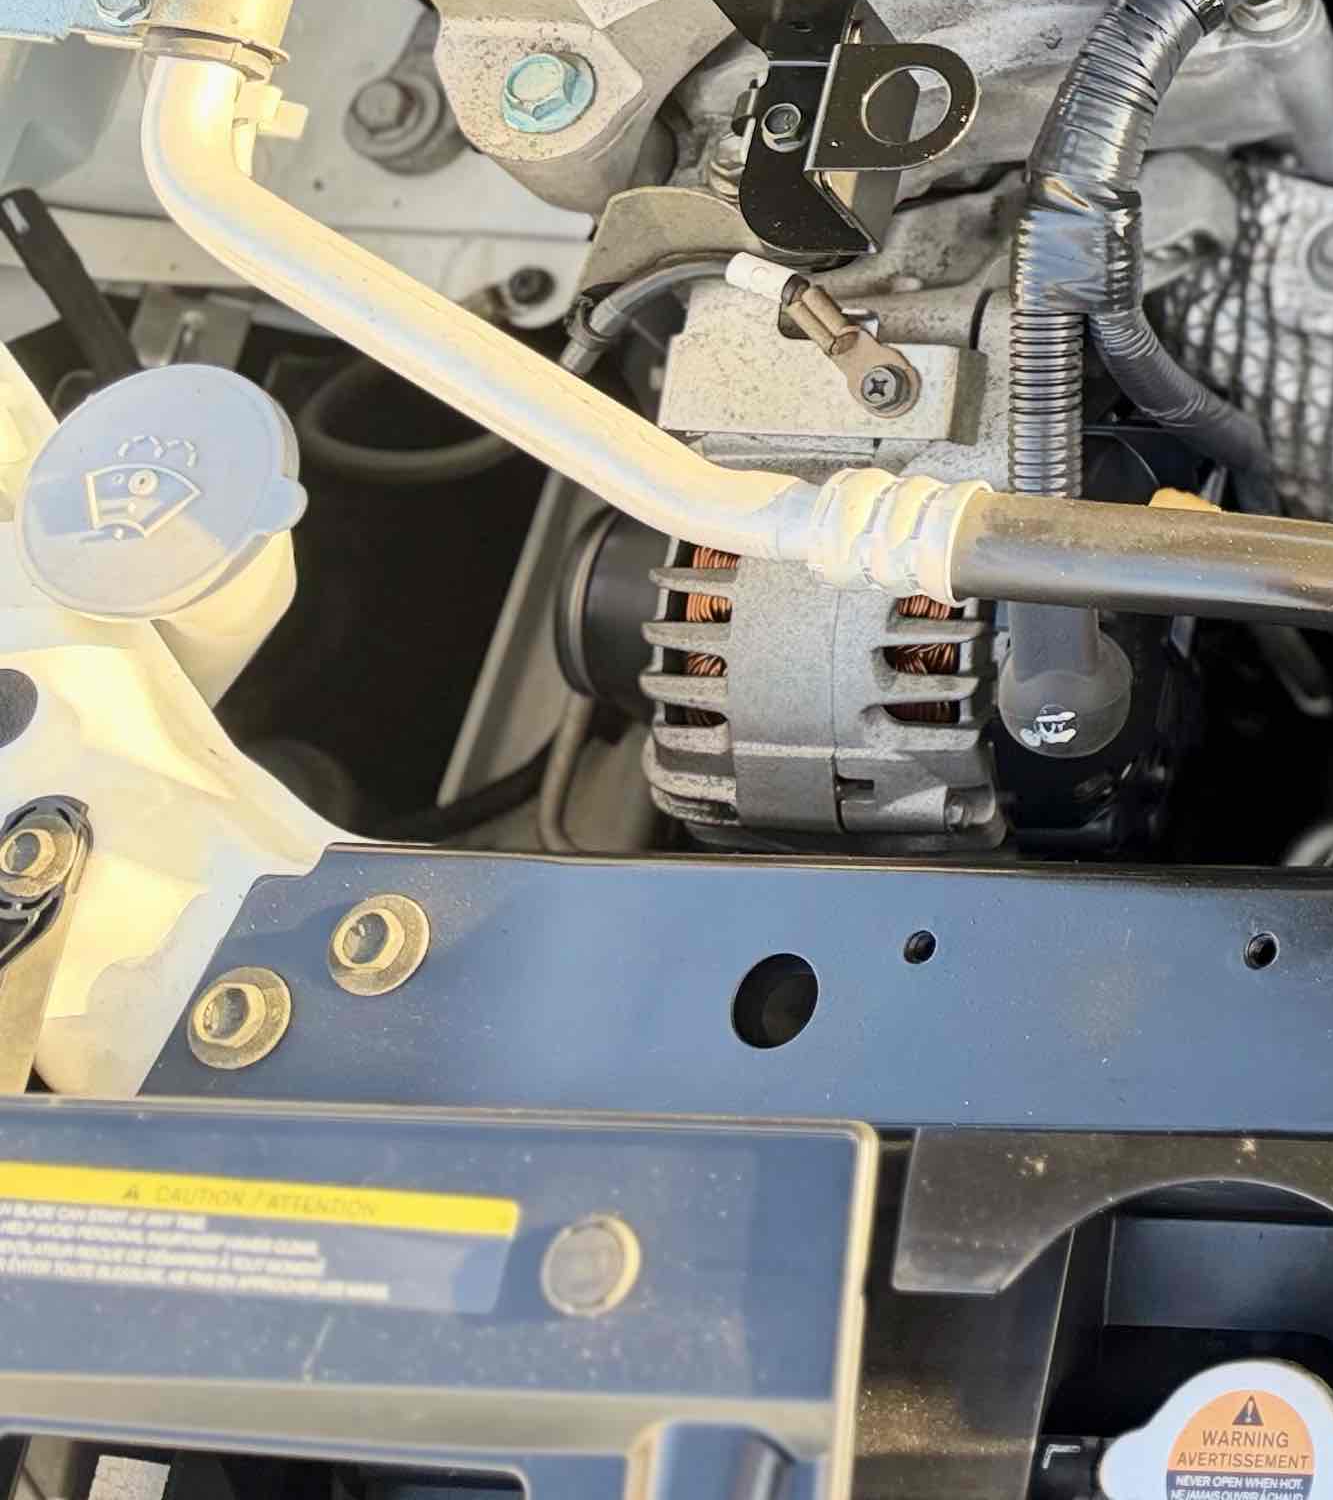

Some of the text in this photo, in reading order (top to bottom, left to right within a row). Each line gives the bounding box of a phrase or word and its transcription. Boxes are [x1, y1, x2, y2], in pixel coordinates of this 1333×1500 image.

[156, 1186, 245, 1207] CAUTION
[268, 1194, 377, 1218] ATTENTION
[1201, 1429, 1289, 1448] WARNING
[1176, 1451, 1311, 1469] AVERTISSEMENT
[1175, 1475, 1211, 1487] NEVER
[1212, 1475, 1243, 1488] OPEN
